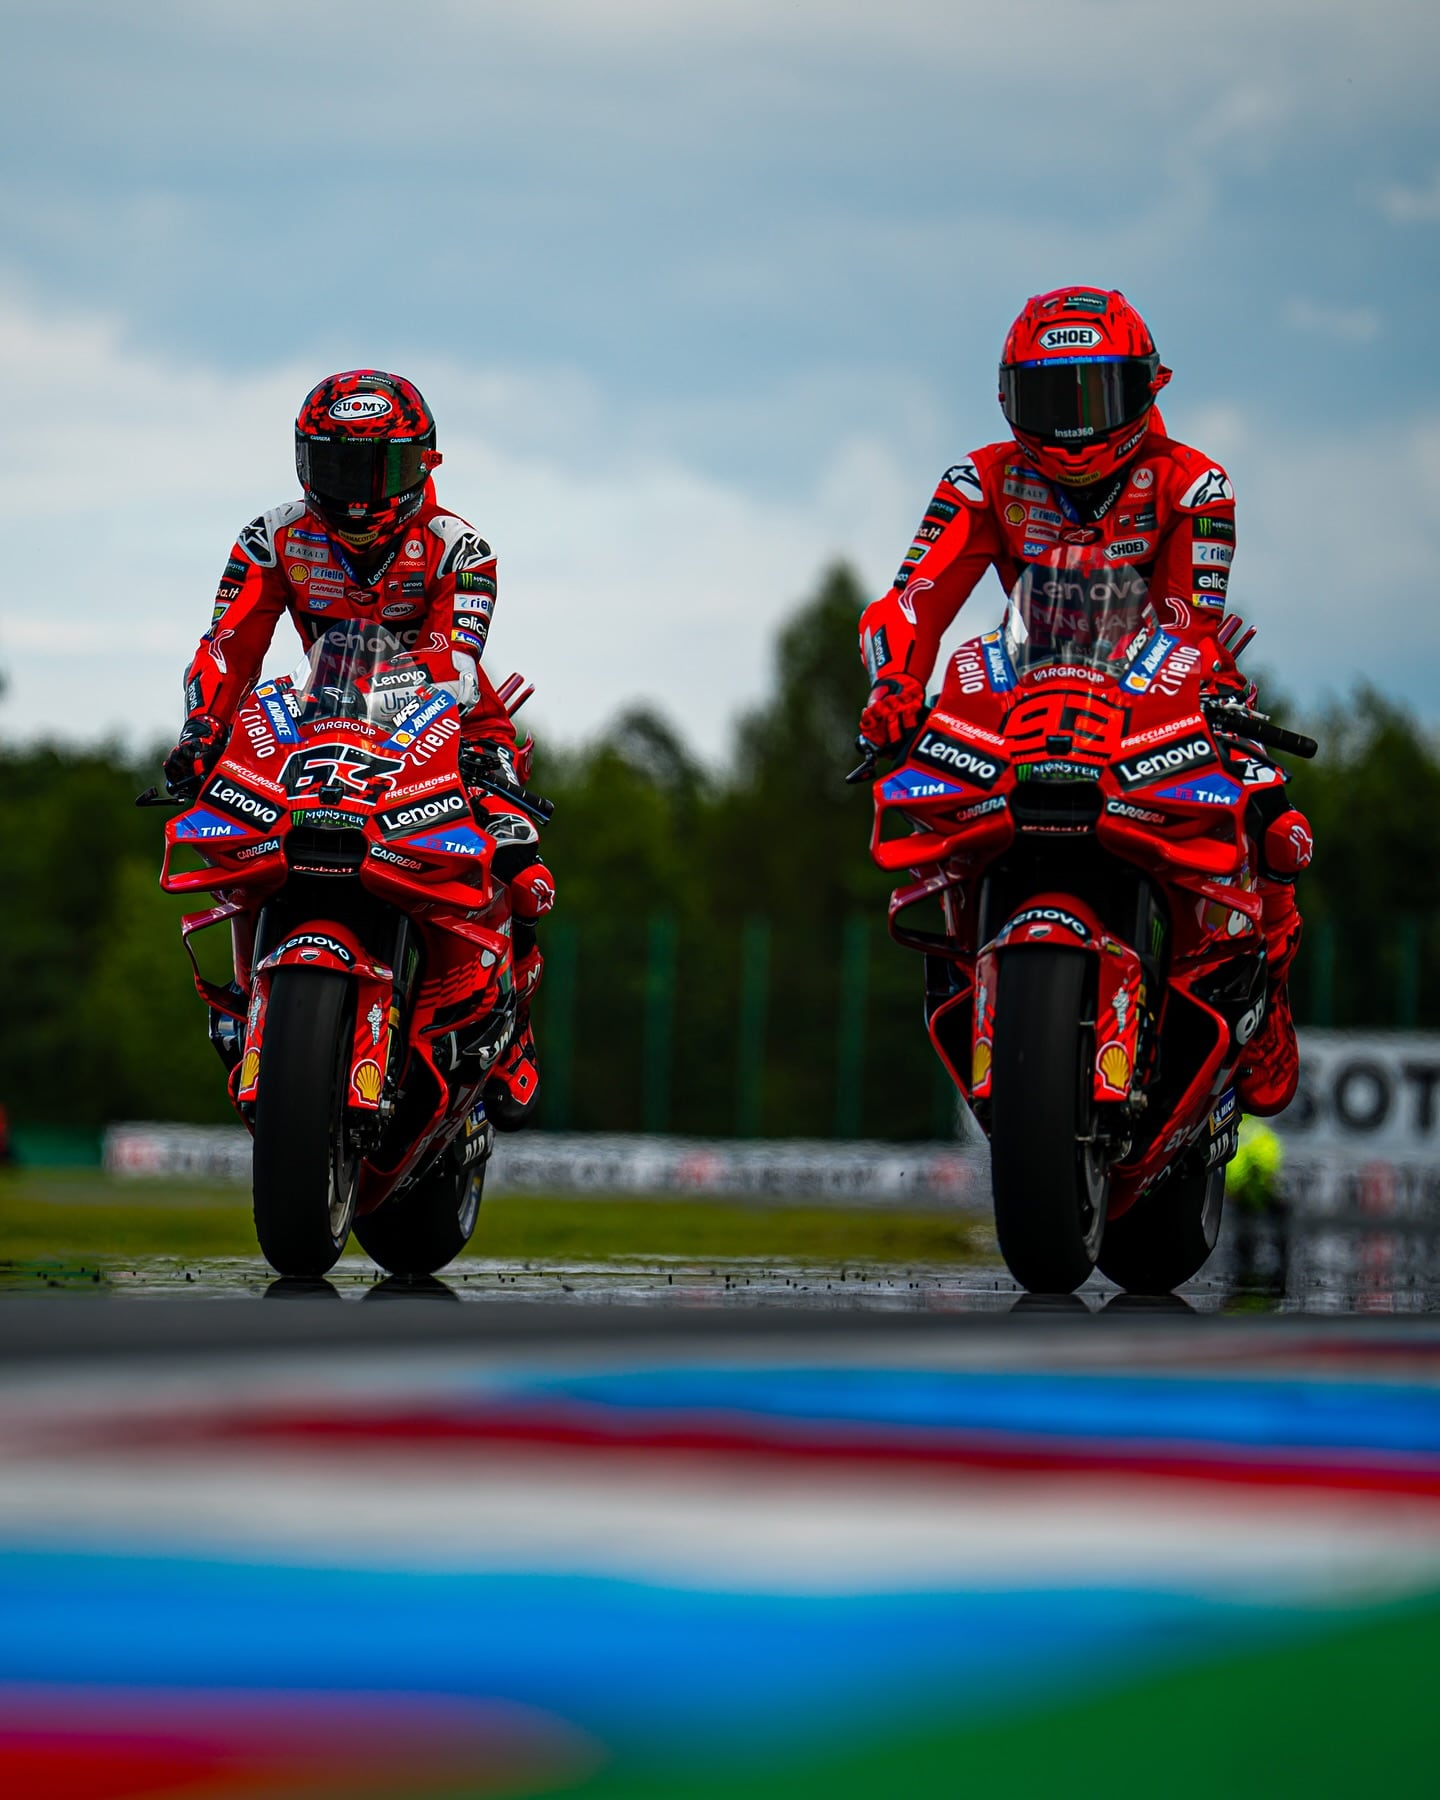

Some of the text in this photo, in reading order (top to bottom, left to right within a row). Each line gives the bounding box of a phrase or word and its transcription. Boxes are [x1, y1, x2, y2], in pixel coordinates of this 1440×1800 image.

[1047, 330, 1093, 346] SHOEI
[335, 402, 386, 412] SUOMY
[1055, 427, 1094, 438] Insta360
[1093, 482, 1121, 519] Lenovo
[1024, 544, 1043, 554] SAP
[1110, 541, 1144, 556] SHOEI
[367, 551, 396, 586] Lenovo
[309, 600, 328, 609] SAP
[371, 670, 427, 688] Lenovo
[955, 652, 986, 695] riello
[1033, 667, 1104, 683] VARGROUP
[1161, 646, 1201, 688] riello
[264, 700, 292, 737] ADVANCE
[282, 693, 302, 719] WRS
[392, 699, 421, 728] WRS
[412, 695, 449, 731] ADVANCE
[241, 713, 276, 759] riello
[313, 720, 376, 737] VARGROUP
[415, 718, 460, 759] riello
[1120, 715, 1202, 748] FRECCIAROSSA
[917, 733, 996, 779] Lenovo
[1120, 739, 1210, 782] Lenovo
[222, 760, 285, 794] FRECCIAROSSA
[1032, 762, 1099, 779] MONSTER
[385, 772, 458, 801] FRECCIAROSSA
[910, 783, 945, 797] TIM
[1196, 790, 1231, 805] TIM
[210, 780, 277, 823] Lenovo
[382, 796, 464, 831] Lenovo
[305, 809, 364, 826] MONSTER
[201, 825, 231, 837] TIM
[237, 840, 279, 860] CARRERA
[370, 846, 422, 870] CARRERA
[445, 841, 475, 855] TIM
